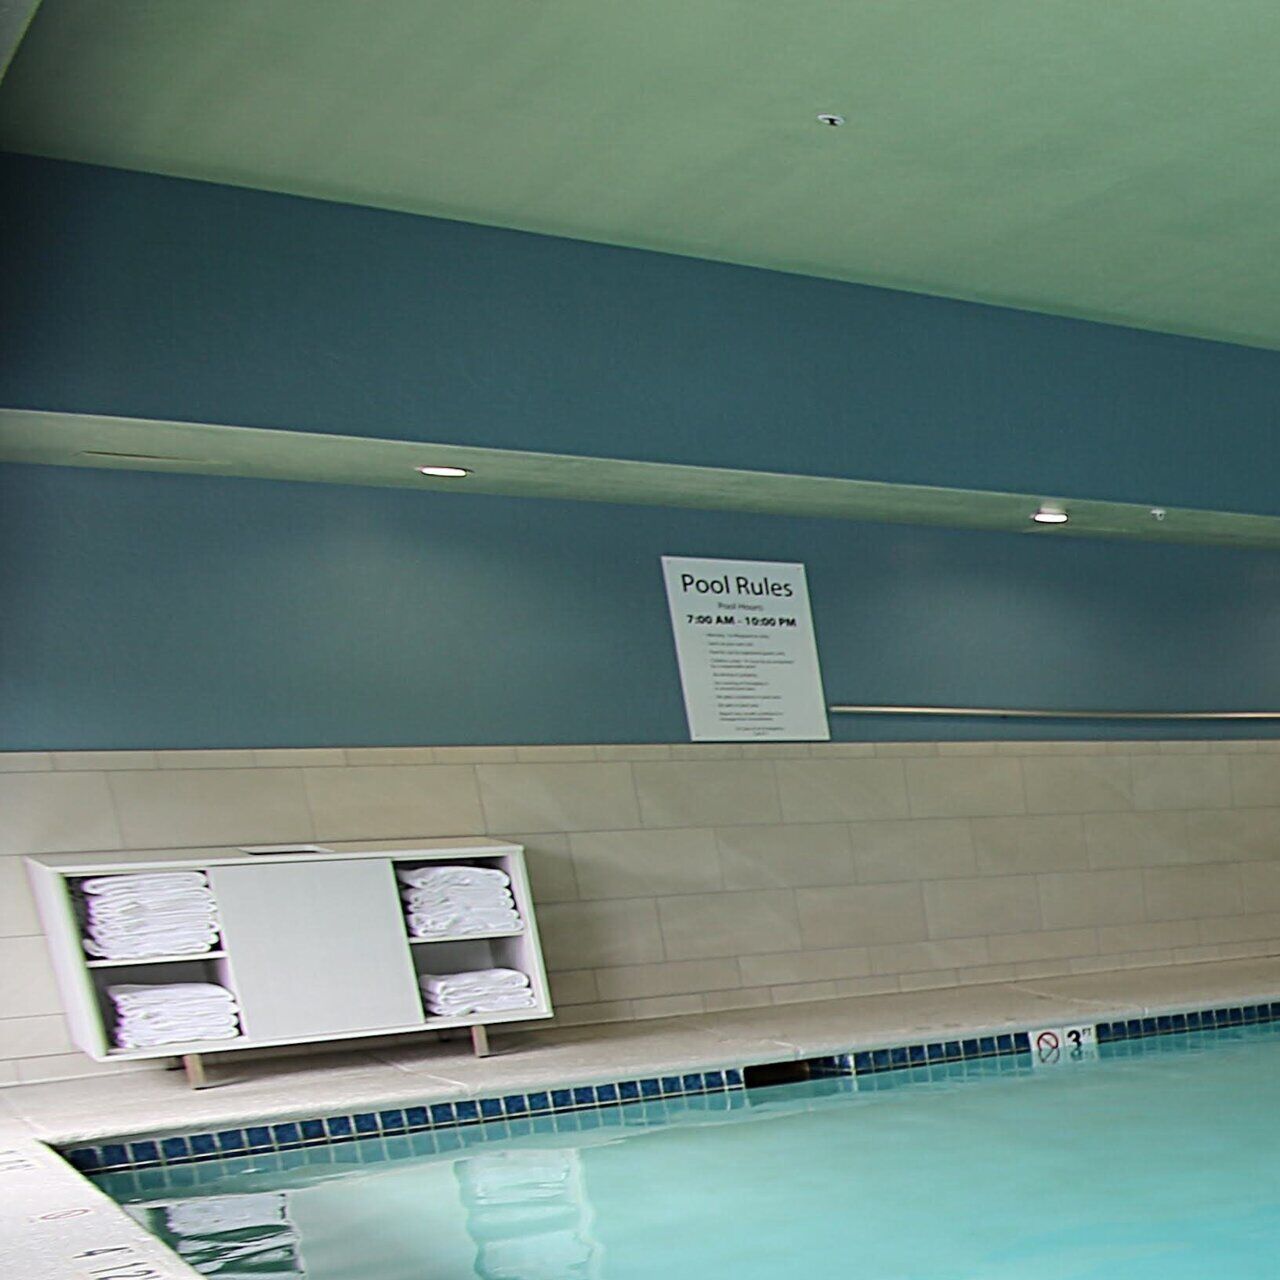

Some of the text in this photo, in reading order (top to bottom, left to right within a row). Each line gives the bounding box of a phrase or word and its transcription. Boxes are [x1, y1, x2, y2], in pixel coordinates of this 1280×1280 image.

[682, 574, 793, 597] Pool Rules
[687, 615, 713, 624] 7:00
[716, 615, 734, 625] AM
[745, 617, 776, 627] 10:00
[778, 618, 797, 627] PM
